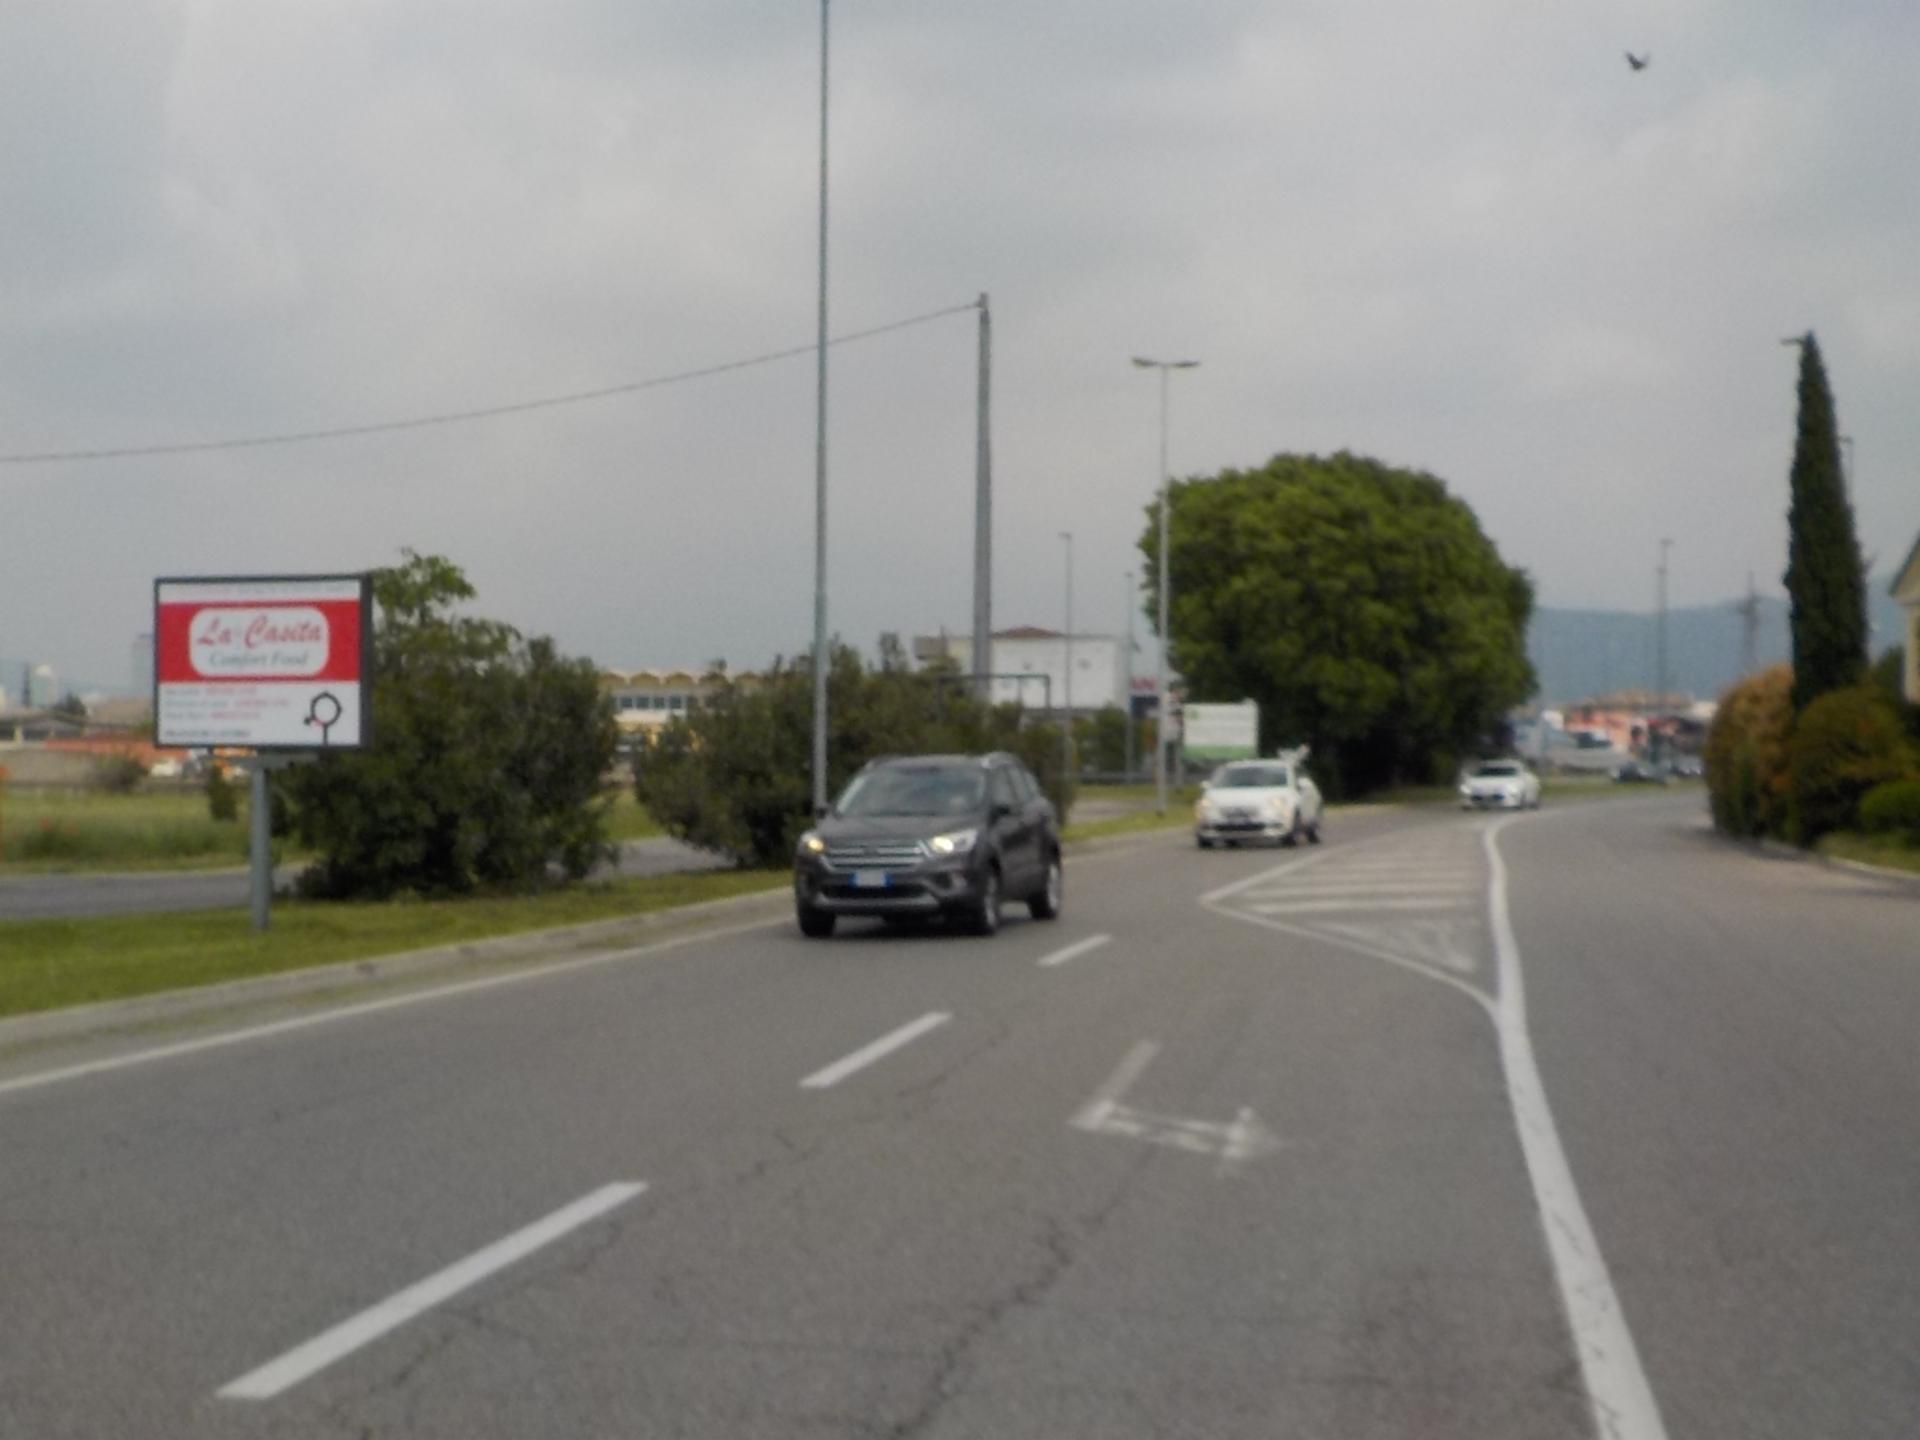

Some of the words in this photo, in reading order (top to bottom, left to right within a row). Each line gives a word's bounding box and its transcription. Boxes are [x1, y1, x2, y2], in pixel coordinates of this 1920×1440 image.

[198, 617, 232, 646] La
[244, 613, 322, 649] Casita
[209, 650, 267, 669] Comfort
[270, 649, 309, 666] Food
